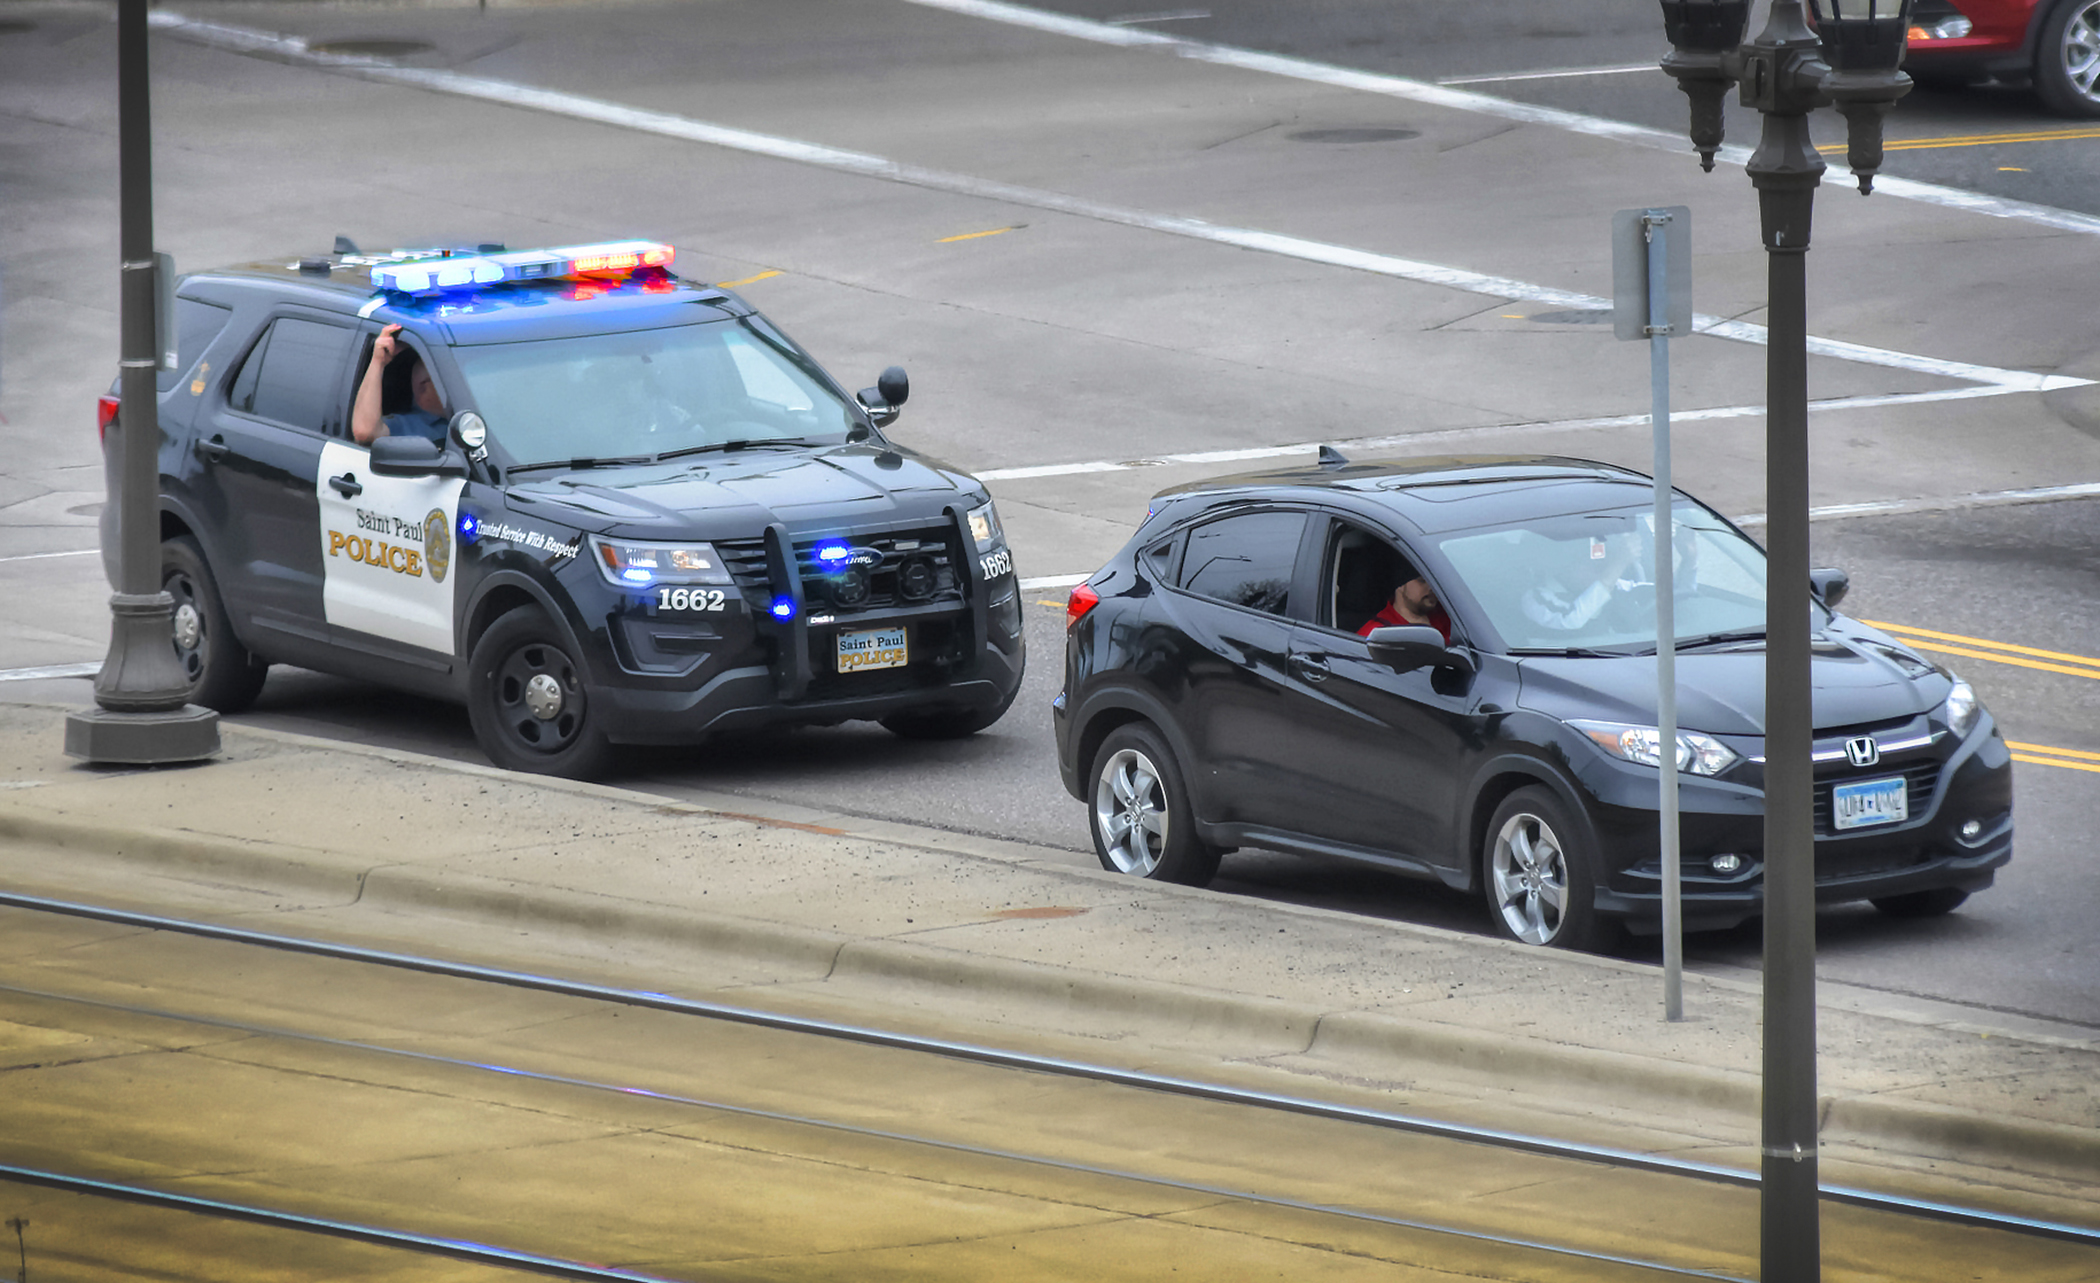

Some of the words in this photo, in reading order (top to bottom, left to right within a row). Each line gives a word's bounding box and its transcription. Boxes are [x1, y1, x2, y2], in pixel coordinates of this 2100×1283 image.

[356, 508, 391, 535] Saint
[392, 517, 423, 542] Paul
[476, 519, 503, 538] Trusted
[500, 525, 527, 544] Service
[525, 531, 546, 549] With
[543, 536, 580, 559] Respect
[328, 530, 423, 578] POLICE
[980, 551, 1011, 581] 1662
[658, 588, 725, 612] 1662
[840, 639, 873, 651] Saint
[877, 634, 904, 647] Paul
[840, 648, 905, 668] POLICE
